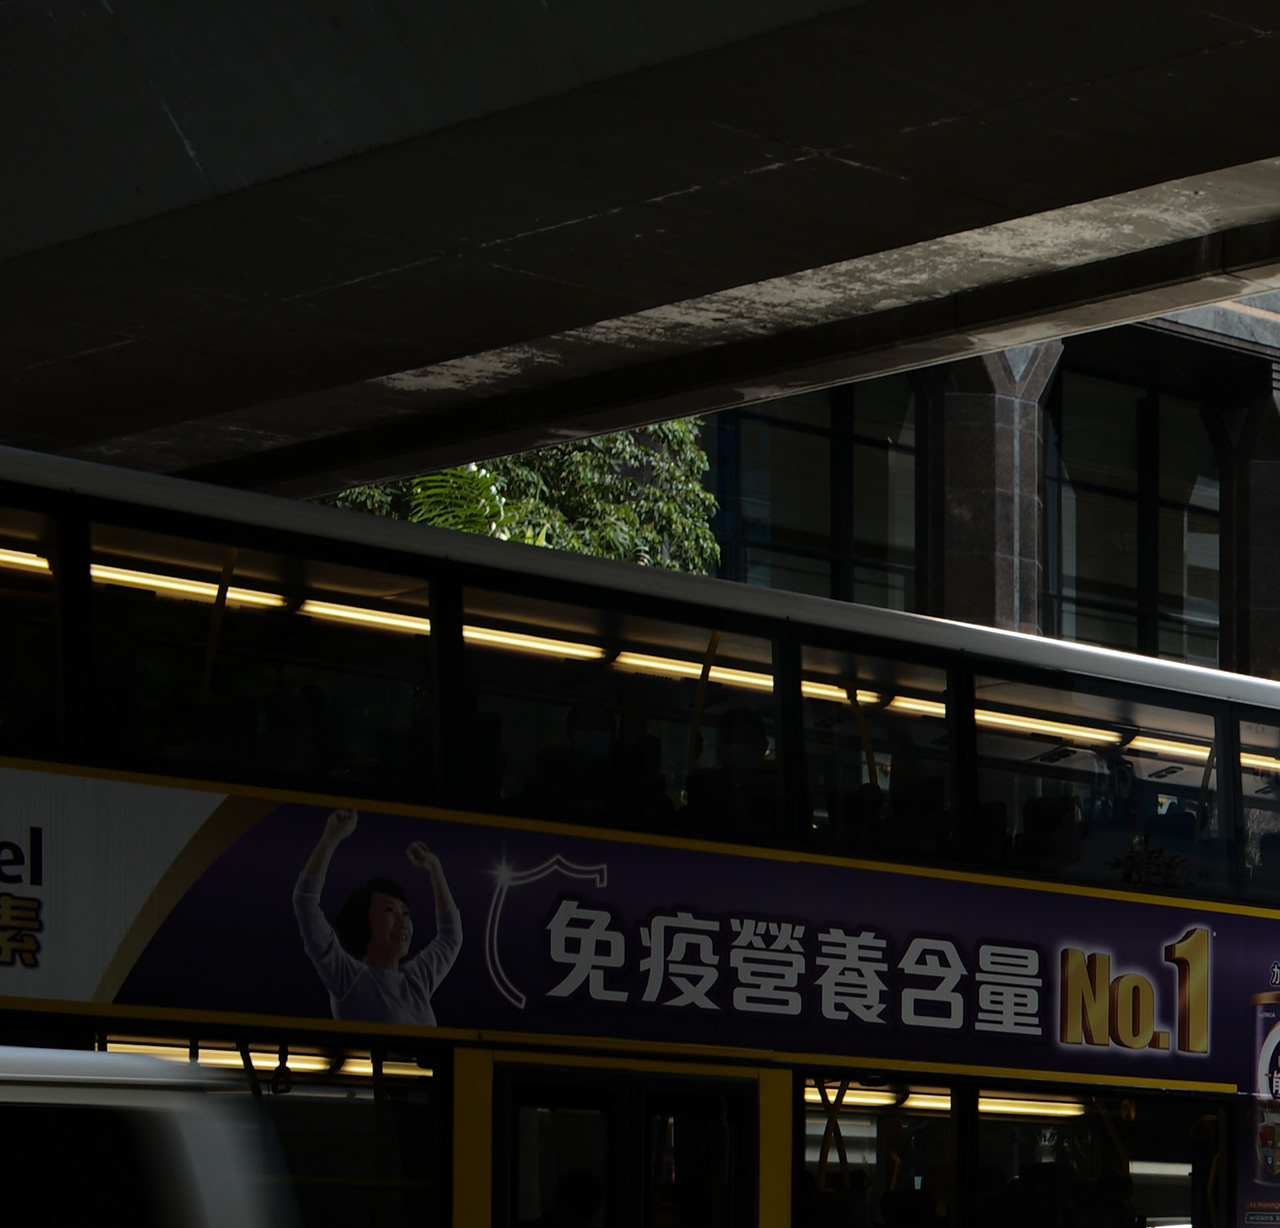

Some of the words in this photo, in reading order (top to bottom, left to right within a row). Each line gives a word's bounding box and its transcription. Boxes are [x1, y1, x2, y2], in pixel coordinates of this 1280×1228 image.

[545, 899, 1043, 1037] 免疫營養含量
[1059, 926, 1213, 1054] No.1
